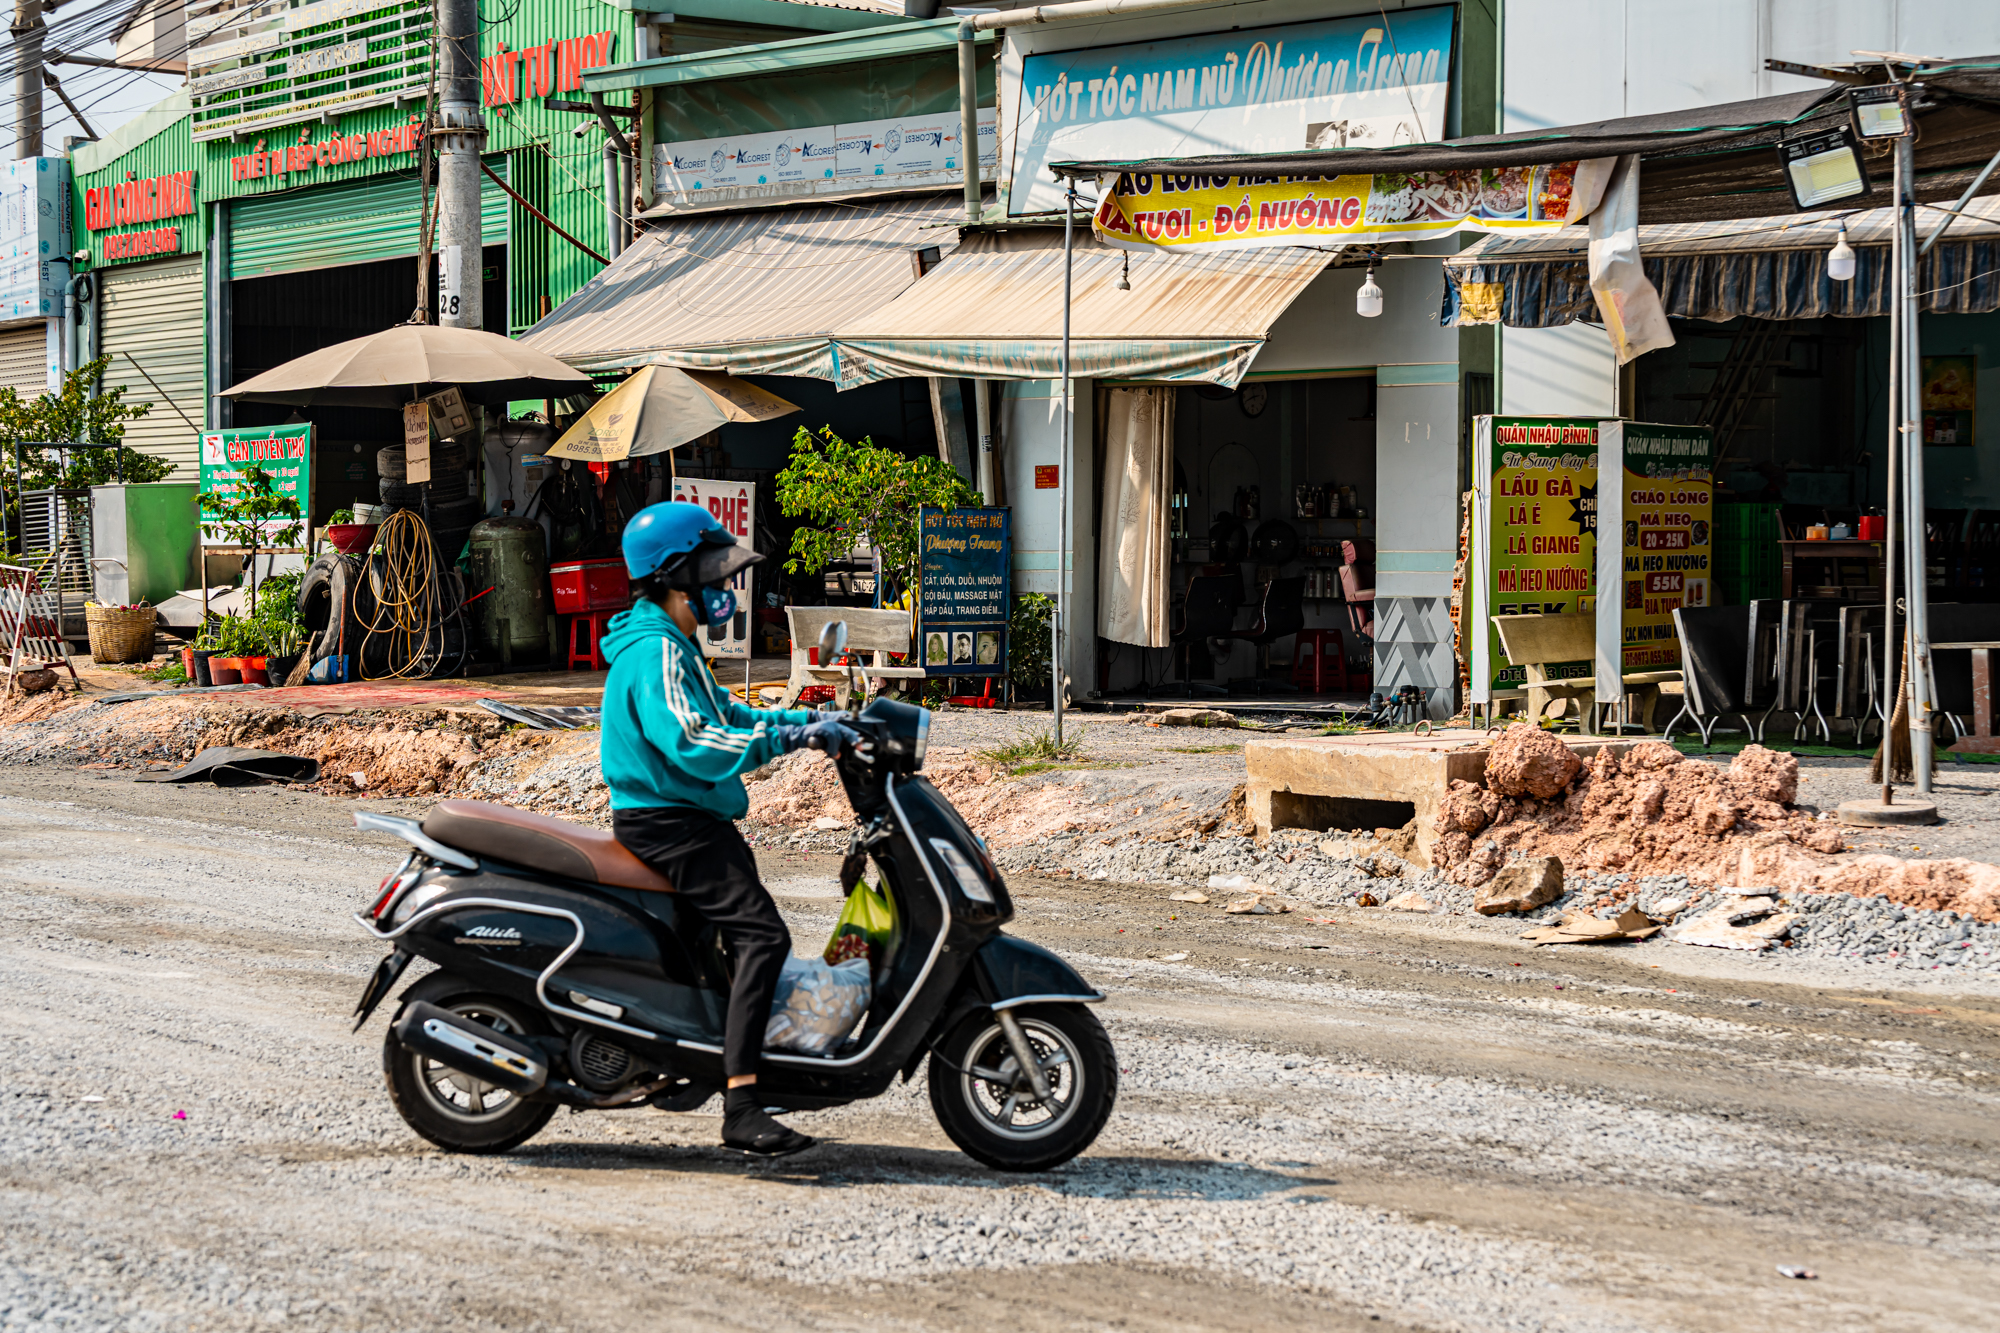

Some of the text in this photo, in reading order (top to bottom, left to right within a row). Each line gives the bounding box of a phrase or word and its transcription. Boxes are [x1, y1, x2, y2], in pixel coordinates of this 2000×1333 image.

[481, 30, 612, 118] VẬT TƯ INOX
[1032, 72, 1084, 124] HỚT
[1088, 65, 1137, 118] TÓC
[1140, 68, 1196, 113] NAM
[1199, 51, 1239, 107] NỮ
[1355, 27, 1441, 110] Trang
[905, 132, 943, 149] ALCOREST
[231, 138, 269, 182] THIẾT
[271, 149, 284, 181] BỊ
[286, 127, 314, 172] BẾP
[316, 130, 363, 168] CÔNG
[673, 154, 707, 170] ALCOREST
[736, 148, 771, 164] ALCOREST
[86, 186, 113, 232] GIA
[113, 170, 154, 228] CÔNG
[155, 169, 197, 219] INOX
[1212, 193, 1253, 236] ĐỒ
[1256, 191, 1362, 233] NƯỚNG
[103, 226, 179, 261] 0937.089.986
[1496, 423, 1527, 446] QUÁN
[1528, 423, 1560, 449] NHẬU
[1561, 424, 1590, 445] BÌNH
[1691, 435, 1709, 456] DÂN
[227, 429, 306, 463] CẦN TUYỂN THỢ
[1522, 452, 1560, 472] Sang
[1500, 471, 1574, 497] LẨU GÀ
[1630, 488, 1709, 506] CHÁO LÒNG
[946, 511, 964, 528] TÓC
[1508, 502, 1541, 526] LÁ É
[1640, 510, 1692, 527] MÁ HEO
[925, 534, 1003, 553] Phượng Trang
[1508, 531, 1580, 555] LÁ GIANG
[1646, 533, 1657, 548] 20
[1666, 532, 1684, 548] 25K
[1625, 552, 1708, 572] MÁ HEO NƯỚNG
[977, 574, 1002, 587] NHUỘM
[1498, 563, 1588, 593] MÁ HEO NƯỚNG
[1652, 575, 1681, 591] 55K
[954, 590, 988, 600] MASSAGE
[956, 605, 981, 615] TRANG
[1645, 597, 1660, 616] BIA
[1625, 624, 1637, 642] CÁC
[1653, 621, 1672, 643] NHẬU
[1650, 650, 1662, 665] 055
[1662, 649, 1675, 664] 205
[1560, 666, 1587, 679] 055
[465, 925, 522, 939] Attila
